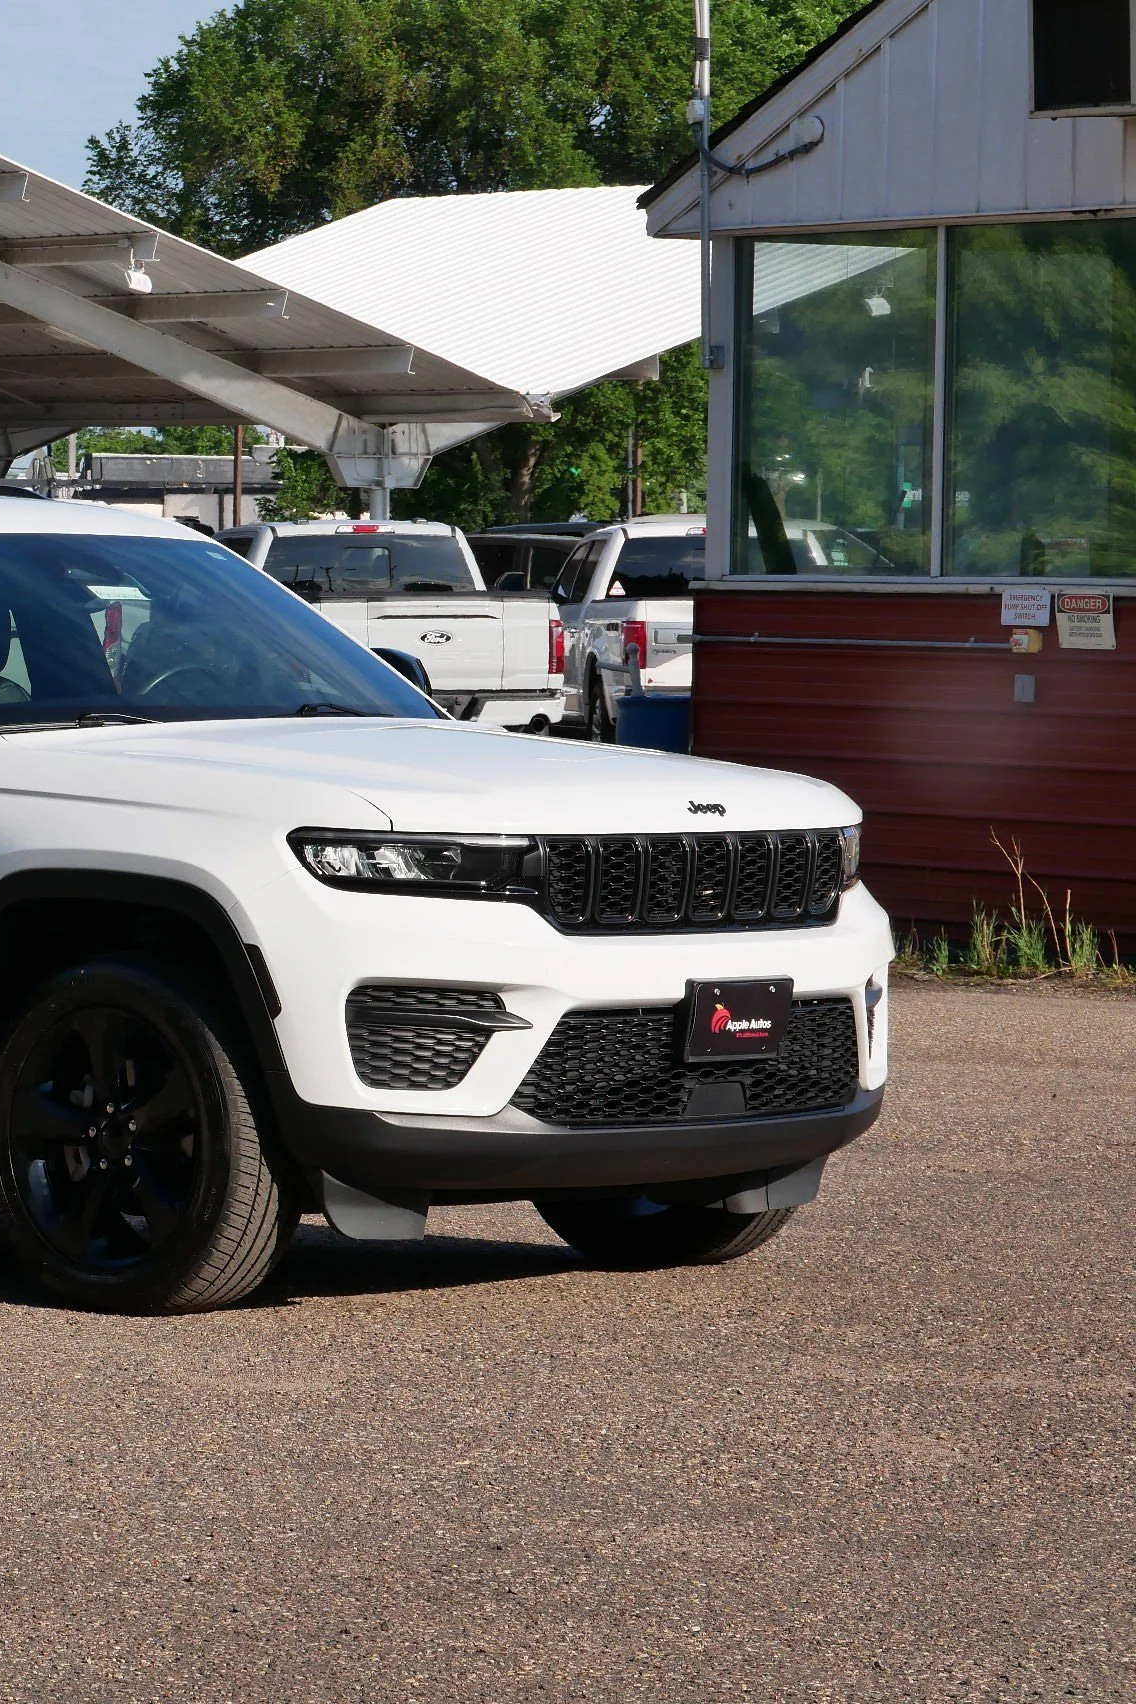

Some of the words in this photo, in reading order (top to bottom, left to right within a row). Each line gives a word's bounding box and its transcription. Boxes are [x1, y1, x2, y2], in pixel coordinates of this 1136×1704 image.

[1009, 594, 1044, 602] EMERGENCY
[1064, 598, 1103, 610] DANGER
[1013, 612, 1037, 621] SWITCH
[1067, 614, 1076, 624] NO
[1076, 614, 1101, 625] SMOKING
[424, 631, 448, 643] Ford
[687, 800, 727, 817] Jeep
[725, 1019, 750, 1032] Apple
[749, 1018, 772, 1030] Autos
